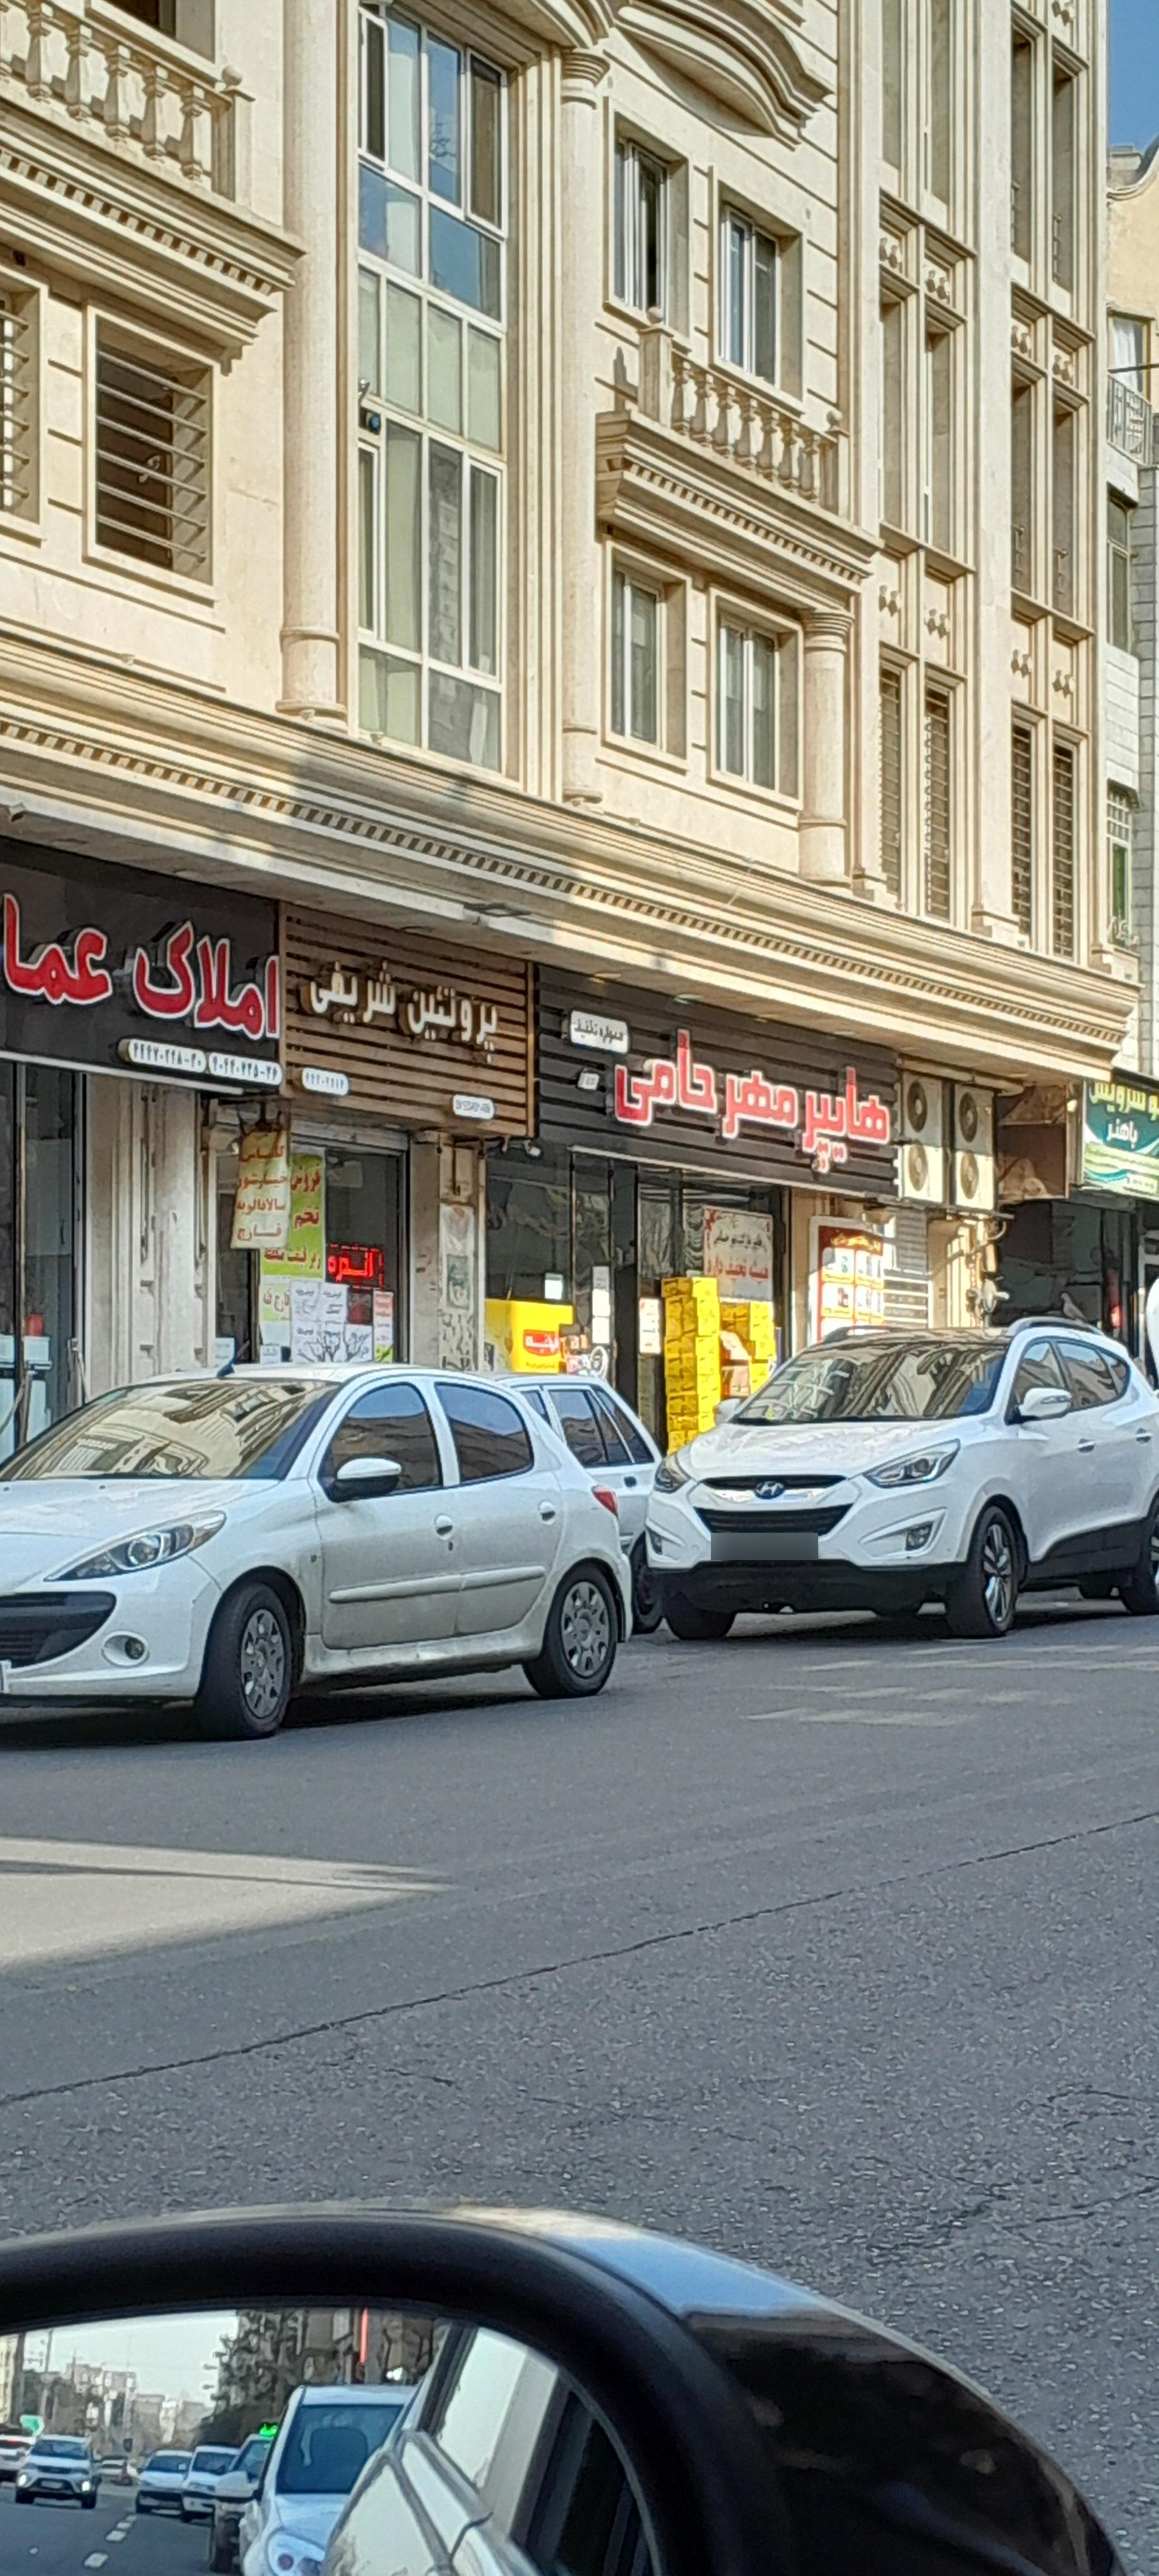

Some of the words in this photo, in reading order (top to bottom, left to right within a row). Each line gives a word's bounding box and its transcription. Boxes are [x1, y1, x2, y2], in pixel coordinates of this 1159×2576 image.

[133, 921, 280, 1040] املاک
[310, 960, 396, 1025] شریفی
[408, 986, 497, 1064] پروتئین
[615, 1030, 717, 1126] حامی
[722, 1071, 799, 1138] مهر
[802, 1067, 890, 1173] هایپر
[1107, 1118, 1138, 1149] باهنر
